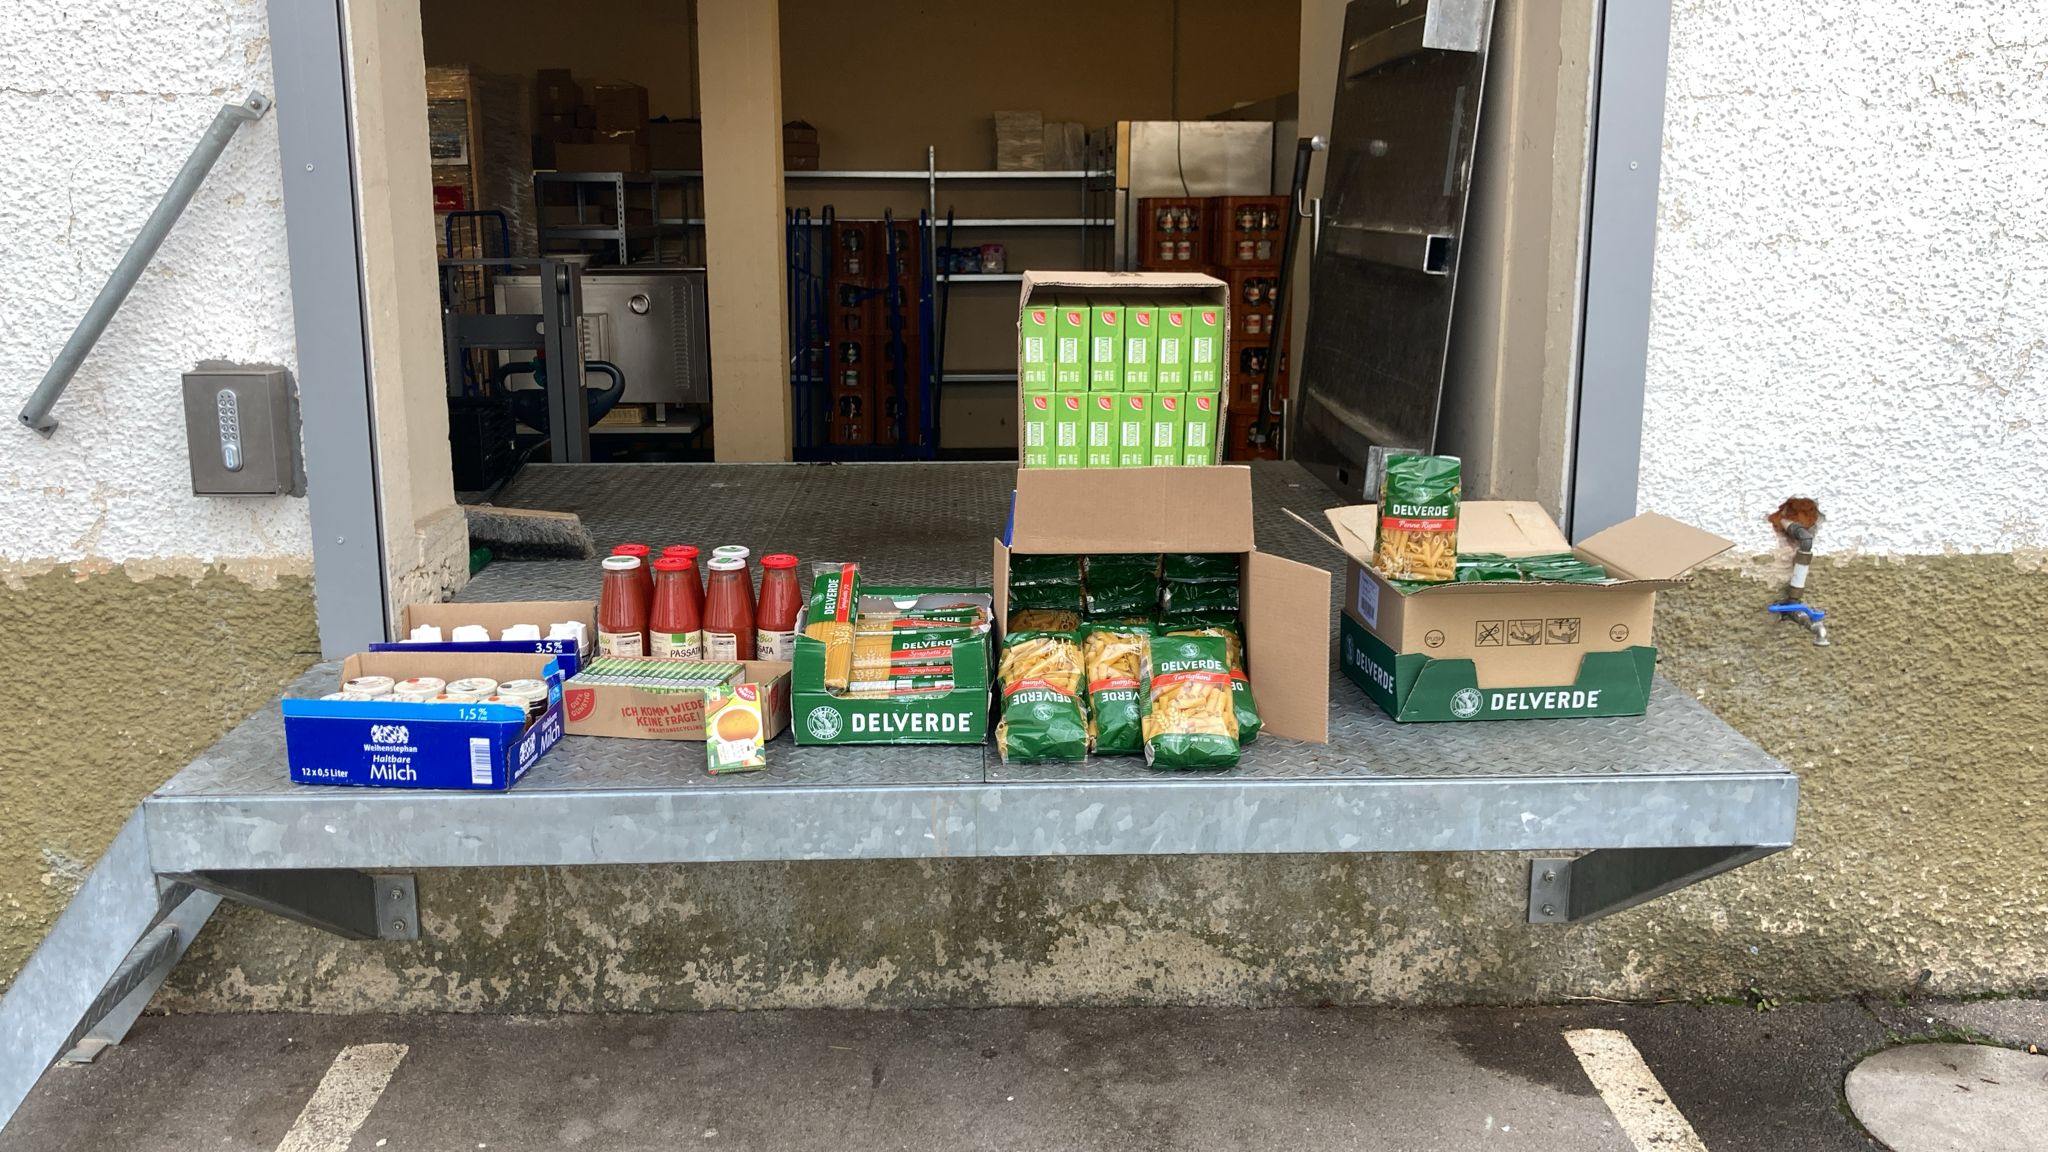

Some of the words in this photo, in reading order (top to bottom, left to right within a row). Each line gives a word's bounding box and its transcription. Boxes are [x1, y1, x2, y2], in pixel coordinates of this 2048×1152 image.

[1393, 504, 1449, 517] DELVERDE
[823, 577, 840, 615] DELVERDE
[1162, 659, 1222, 673] DELVERDE
[1356, 648, 1395, 695] DELVERDE
[1101, 691, 1140, 703] VERDE
[1491, 690, 1599, 711] DELVERDE
[621, 706, 638, 717] ICH
[640, 705, 669, 717] KOMM
[671, 698, 704, 714] WIEDE
[636, 716, 663, 727] KEINE
[666, 711, 700, 726] FRAGE!
[852, 712, 971, 733] DELVERDE
[540, 721, 560, 755] Milch
[363, 743, 418, 753] Weihenstephan
[373, 754, 411, 764] Haltbare
[302, 767, 311, 776] 12
[318, 768, 329, 778] 0,5
[330, 769, 348, 778] Liter
[370, 763, 417, 781] Milch
